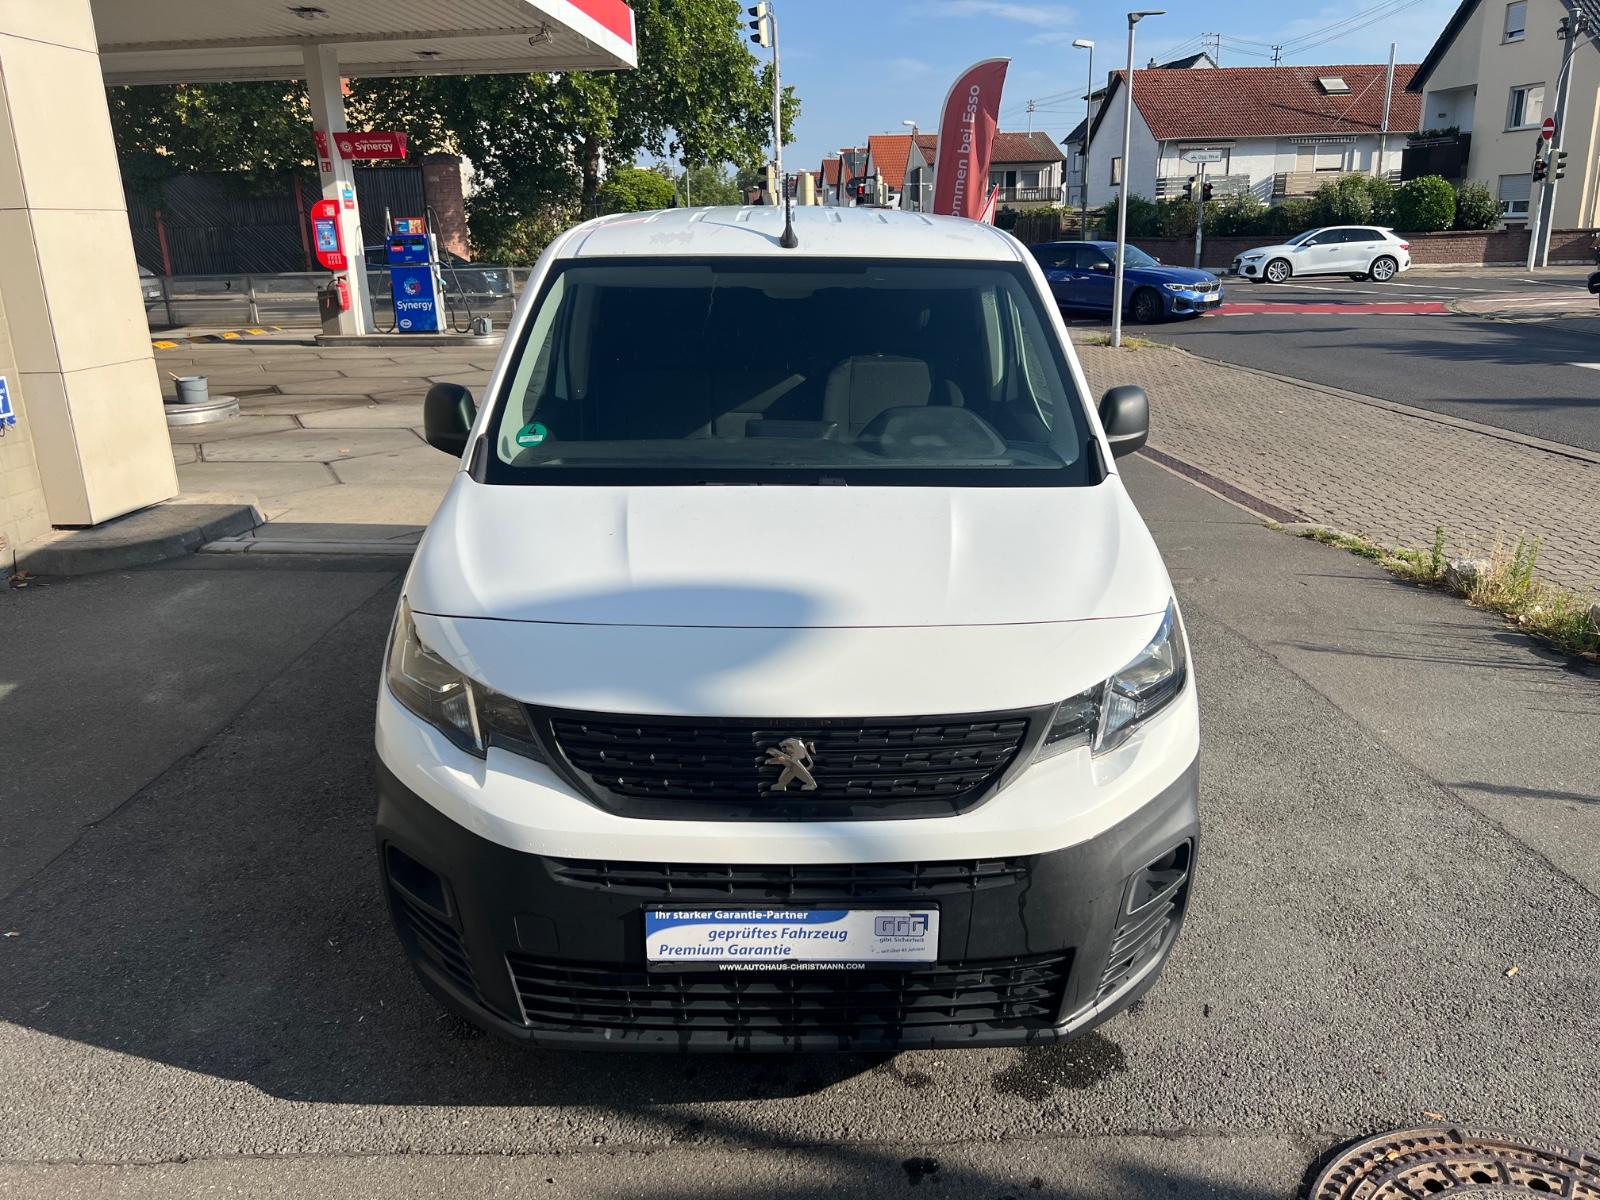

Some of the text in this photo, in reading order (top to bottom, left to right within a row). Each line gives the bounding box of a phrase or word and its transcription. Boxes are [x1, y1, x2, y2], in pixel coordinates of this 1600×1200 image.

[962, 84, 980, 123] Esso
[957, 128, 974, 154] bei
[354, 142, 393, 153] Synergy
[397, 300, 433, 312] Synergy
[527, 424, 537, 435] 4
[655, 910, 809, 920] Ihr starker Garantie-Partner
[708, 927, 848, 942] geprüftes Fahrzeug
[659, 944, 792, 955] Premium Garantie
[718, 963, 866, 971] WWW.AUTOHAUS-CHRISTMANN.COM
